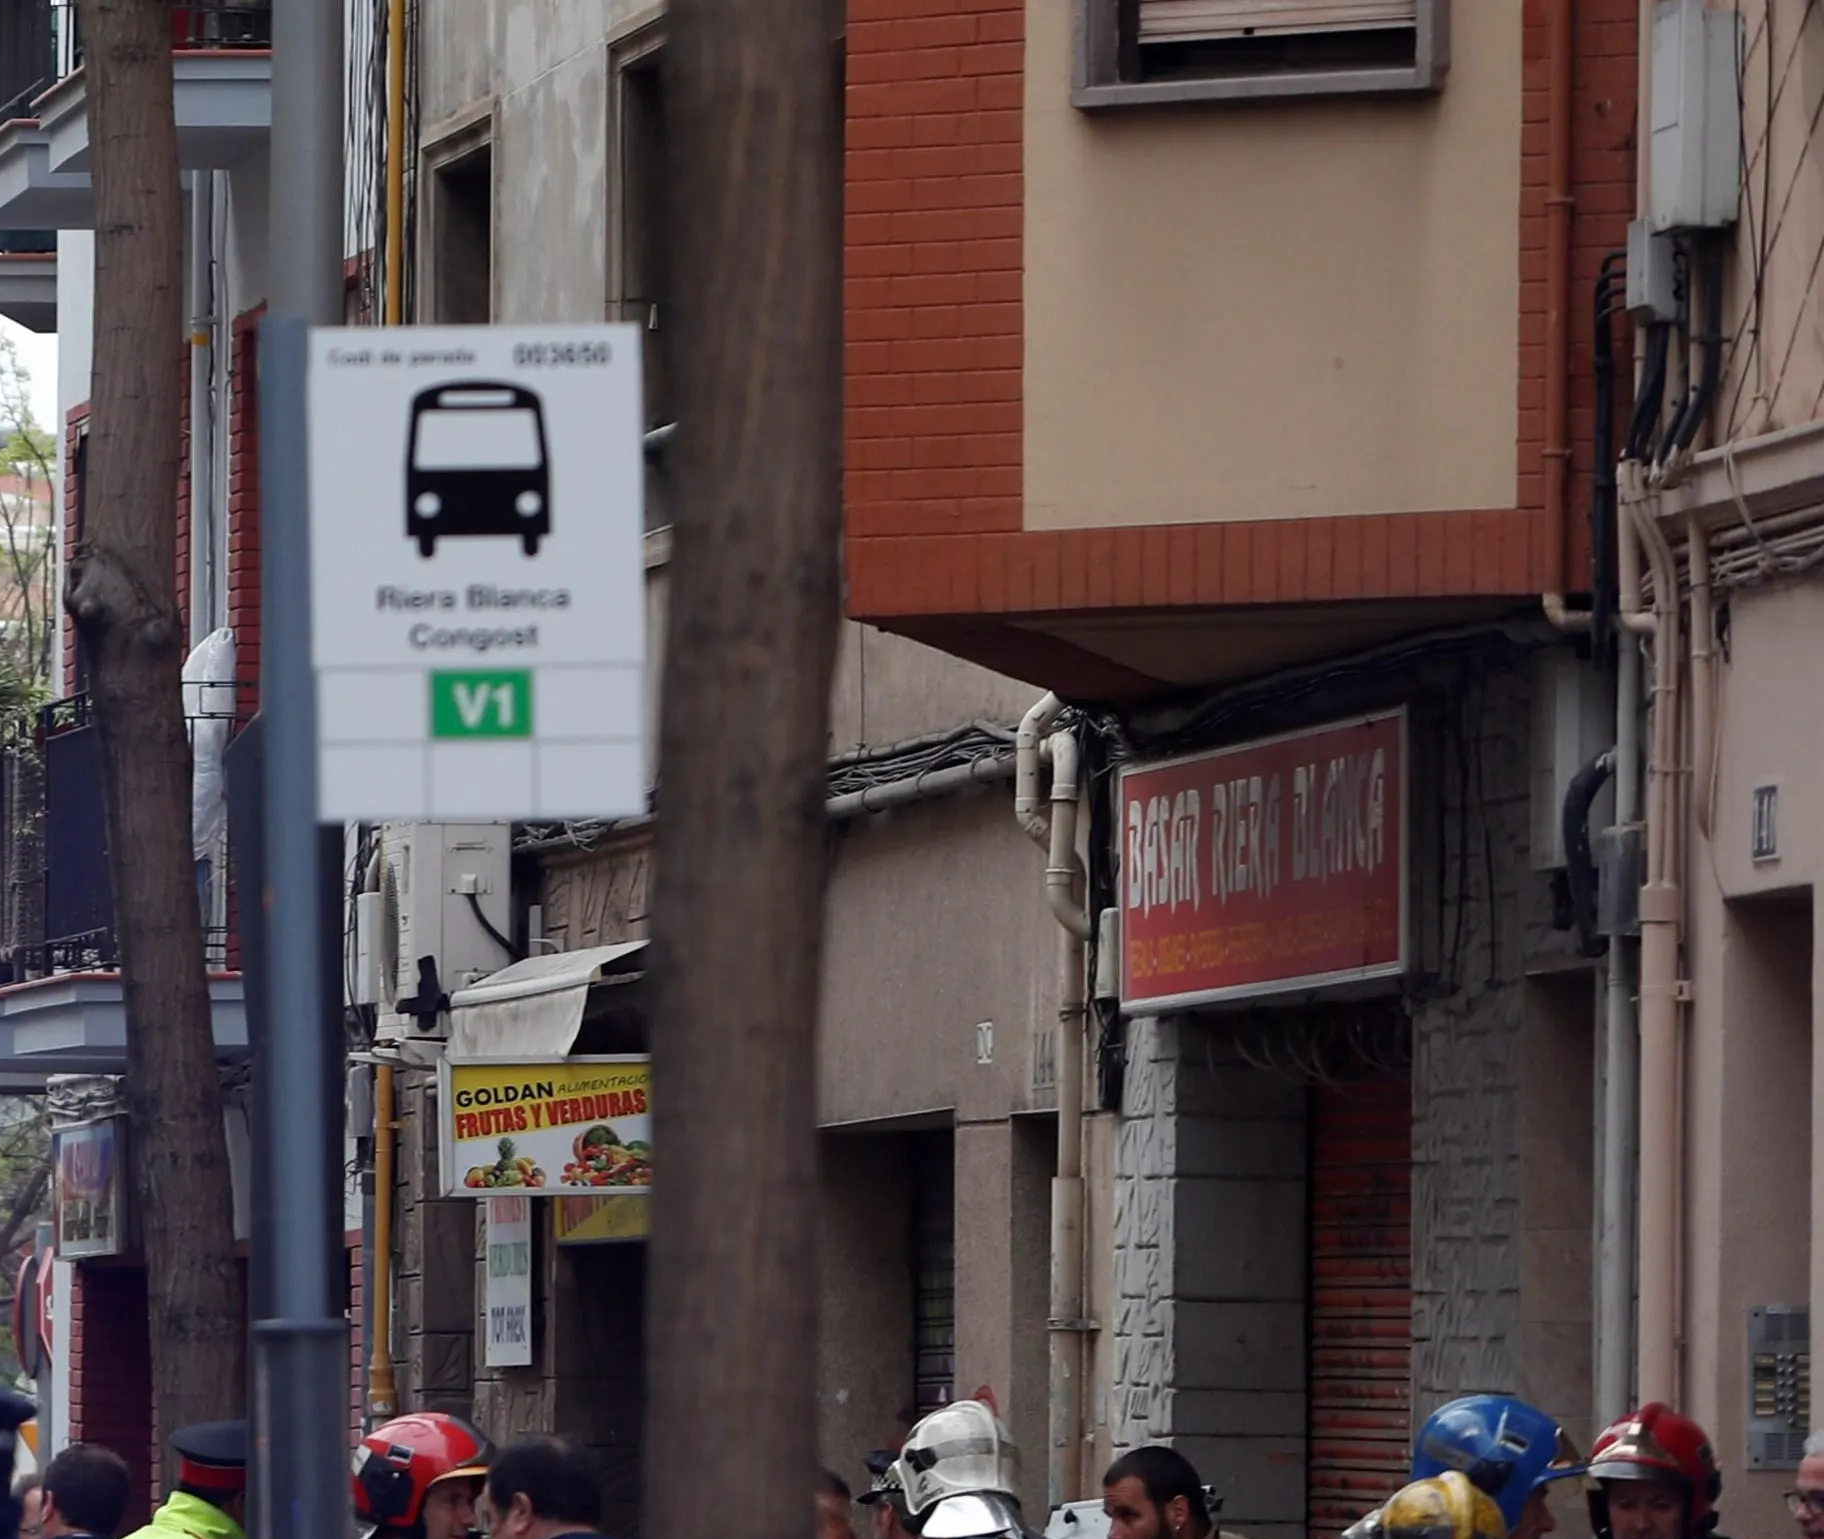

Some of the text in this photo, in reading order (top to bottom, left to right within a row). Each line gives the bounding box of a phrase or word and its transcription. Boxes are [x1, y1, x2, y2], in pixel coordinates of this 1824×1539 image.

[375, 583, 571, 612] Riera Blanca
[407, 621, 538, 656] Congost
[452, 681, 515, 729] V1
[1128, 748, 1385, 919] BASAR RIERA BLANCA
[455, 1081, 554, 1109] GOLDAN
[455, 1088, 648, 1140] FRUTAS Y VERDURAS
